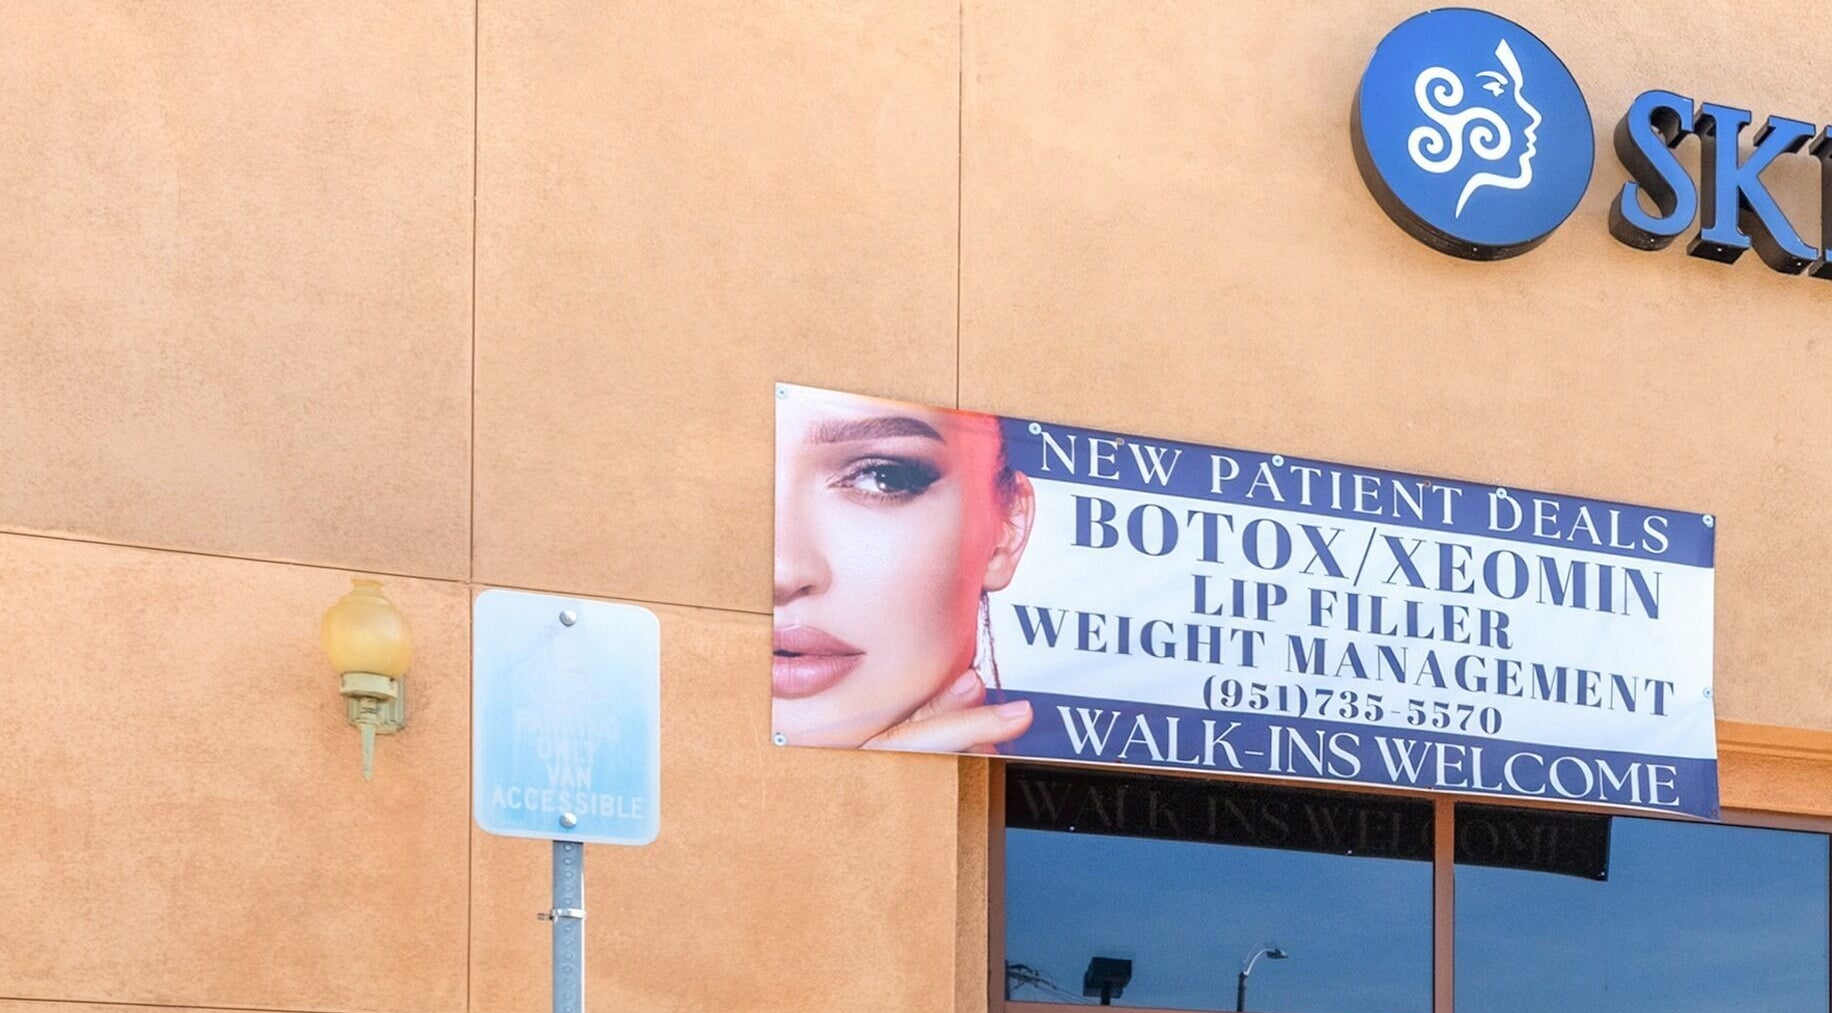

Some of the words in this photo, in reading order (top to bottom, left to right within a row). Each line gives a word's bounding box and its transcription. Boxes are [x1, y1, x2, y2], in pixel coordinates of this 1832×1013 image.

[1041, 430, 1182, 486] NEW
[1210, 453, 1463, 526] PATIENT
[1488, 493, 1670, 553] DEALS
[1070, 493, 1662, 620] BOTOX/XEOMIN
[1190, 574, 1288, 623] LIP
[1307, 588, 1514, 650] FILLER
[1013, 604, 1266, 668] WEIGHT
[1285, 634, 1675, 717] MANAGEMENT
[1202, 673, 1503, 735] (951)735-5570
[545, 761, 593, 790] VAN
[1056, 705, 1361, 779] WALK-INS
[1373, 735, 1681, 806] WELCOME
[491, 785, 645, 820] ACCESSIBLE
